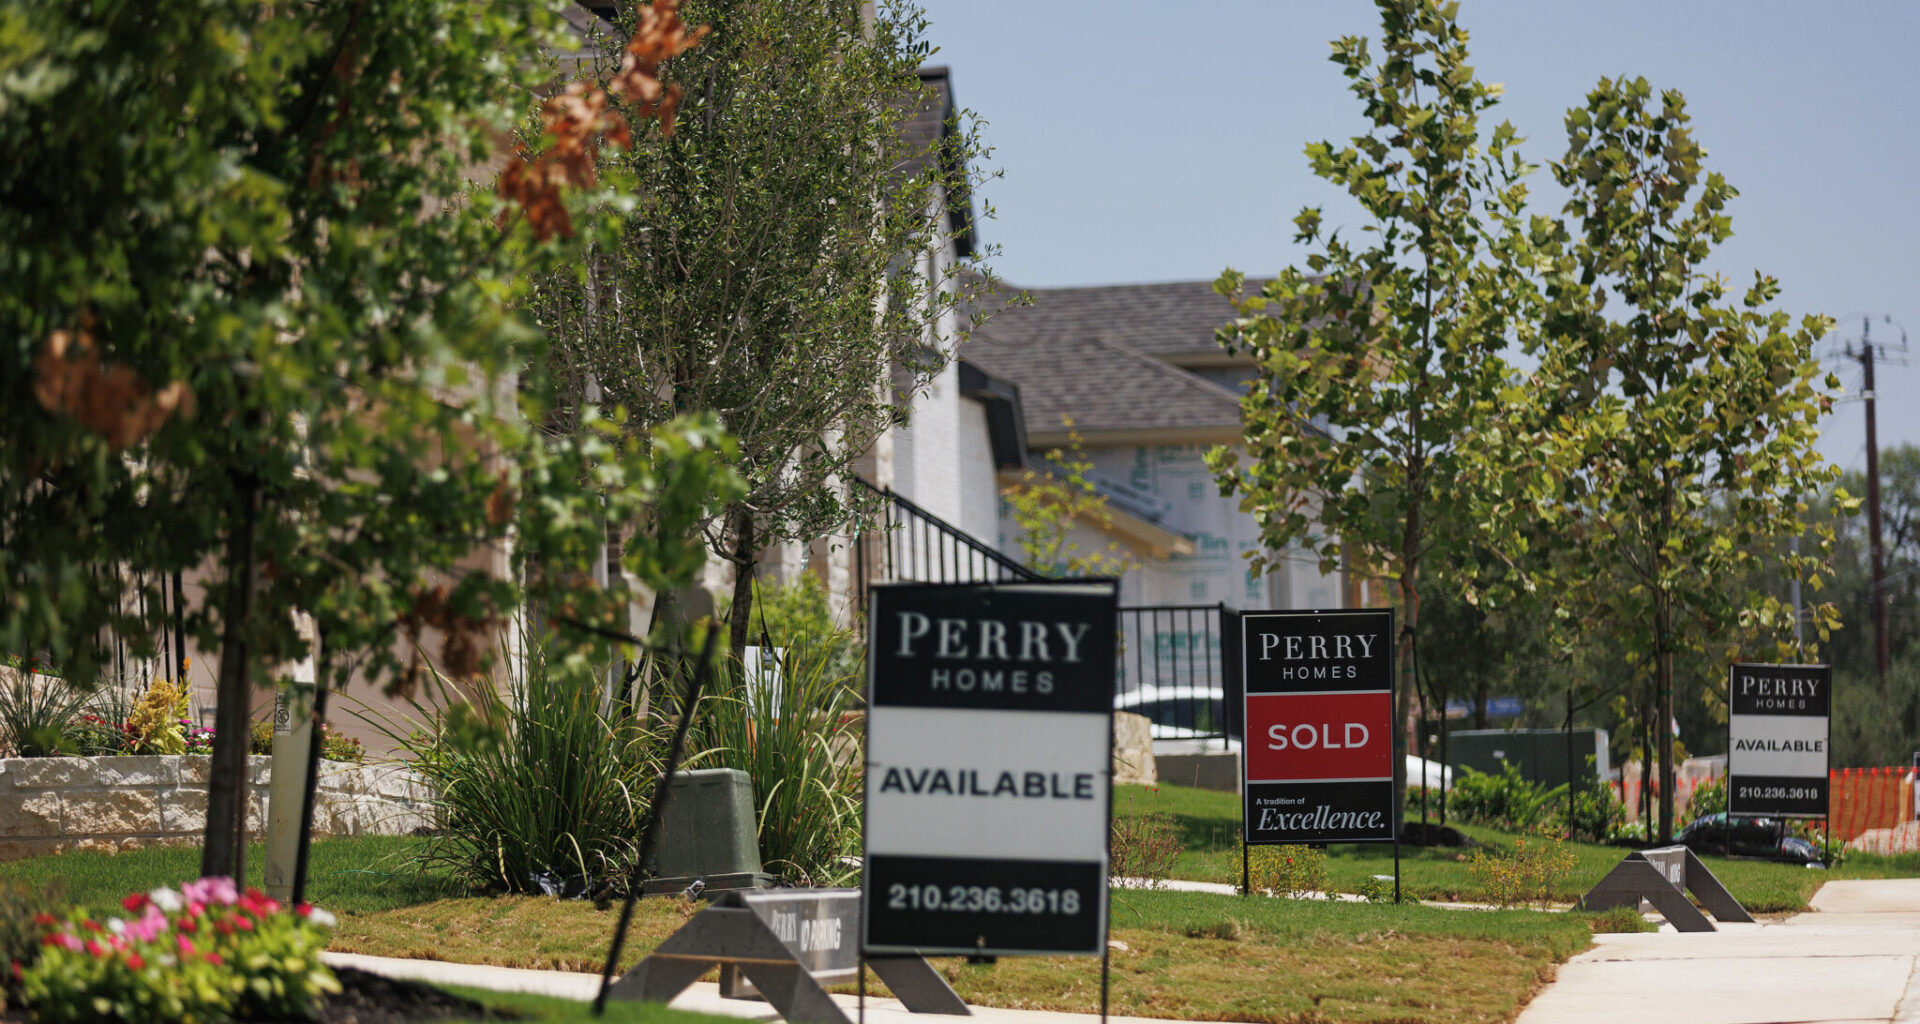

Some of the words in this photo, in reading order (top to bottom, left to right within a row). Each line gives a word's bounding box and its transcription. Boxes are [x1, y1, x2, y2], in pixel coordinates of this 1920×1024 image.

[895, 610, 1091, 663] PERRY
[1258, 633, 1377, 661] PERRY
[931, 667, 1055, 694] HOMES
[1282, 665, 1357, 680] HOMES
[1740, 675, 1820, 698] PERRY
[1755, 698, 1806, 710] HOMES
[1268, 722, 1369, 750] SOLD
[1735, 739, 1823, 753] AVAILABLE
[879, 766, 1095, 800] AVAILABLE
[1739, 786, 1818, 800] 210.236.3618
[1264, 797, 1296, 805] tradition
[1297, 797, 1305, 805] of
[1257, 805, 1385, 831] Excellence.
[889, 883, 1081, 915] 210.236.3618
